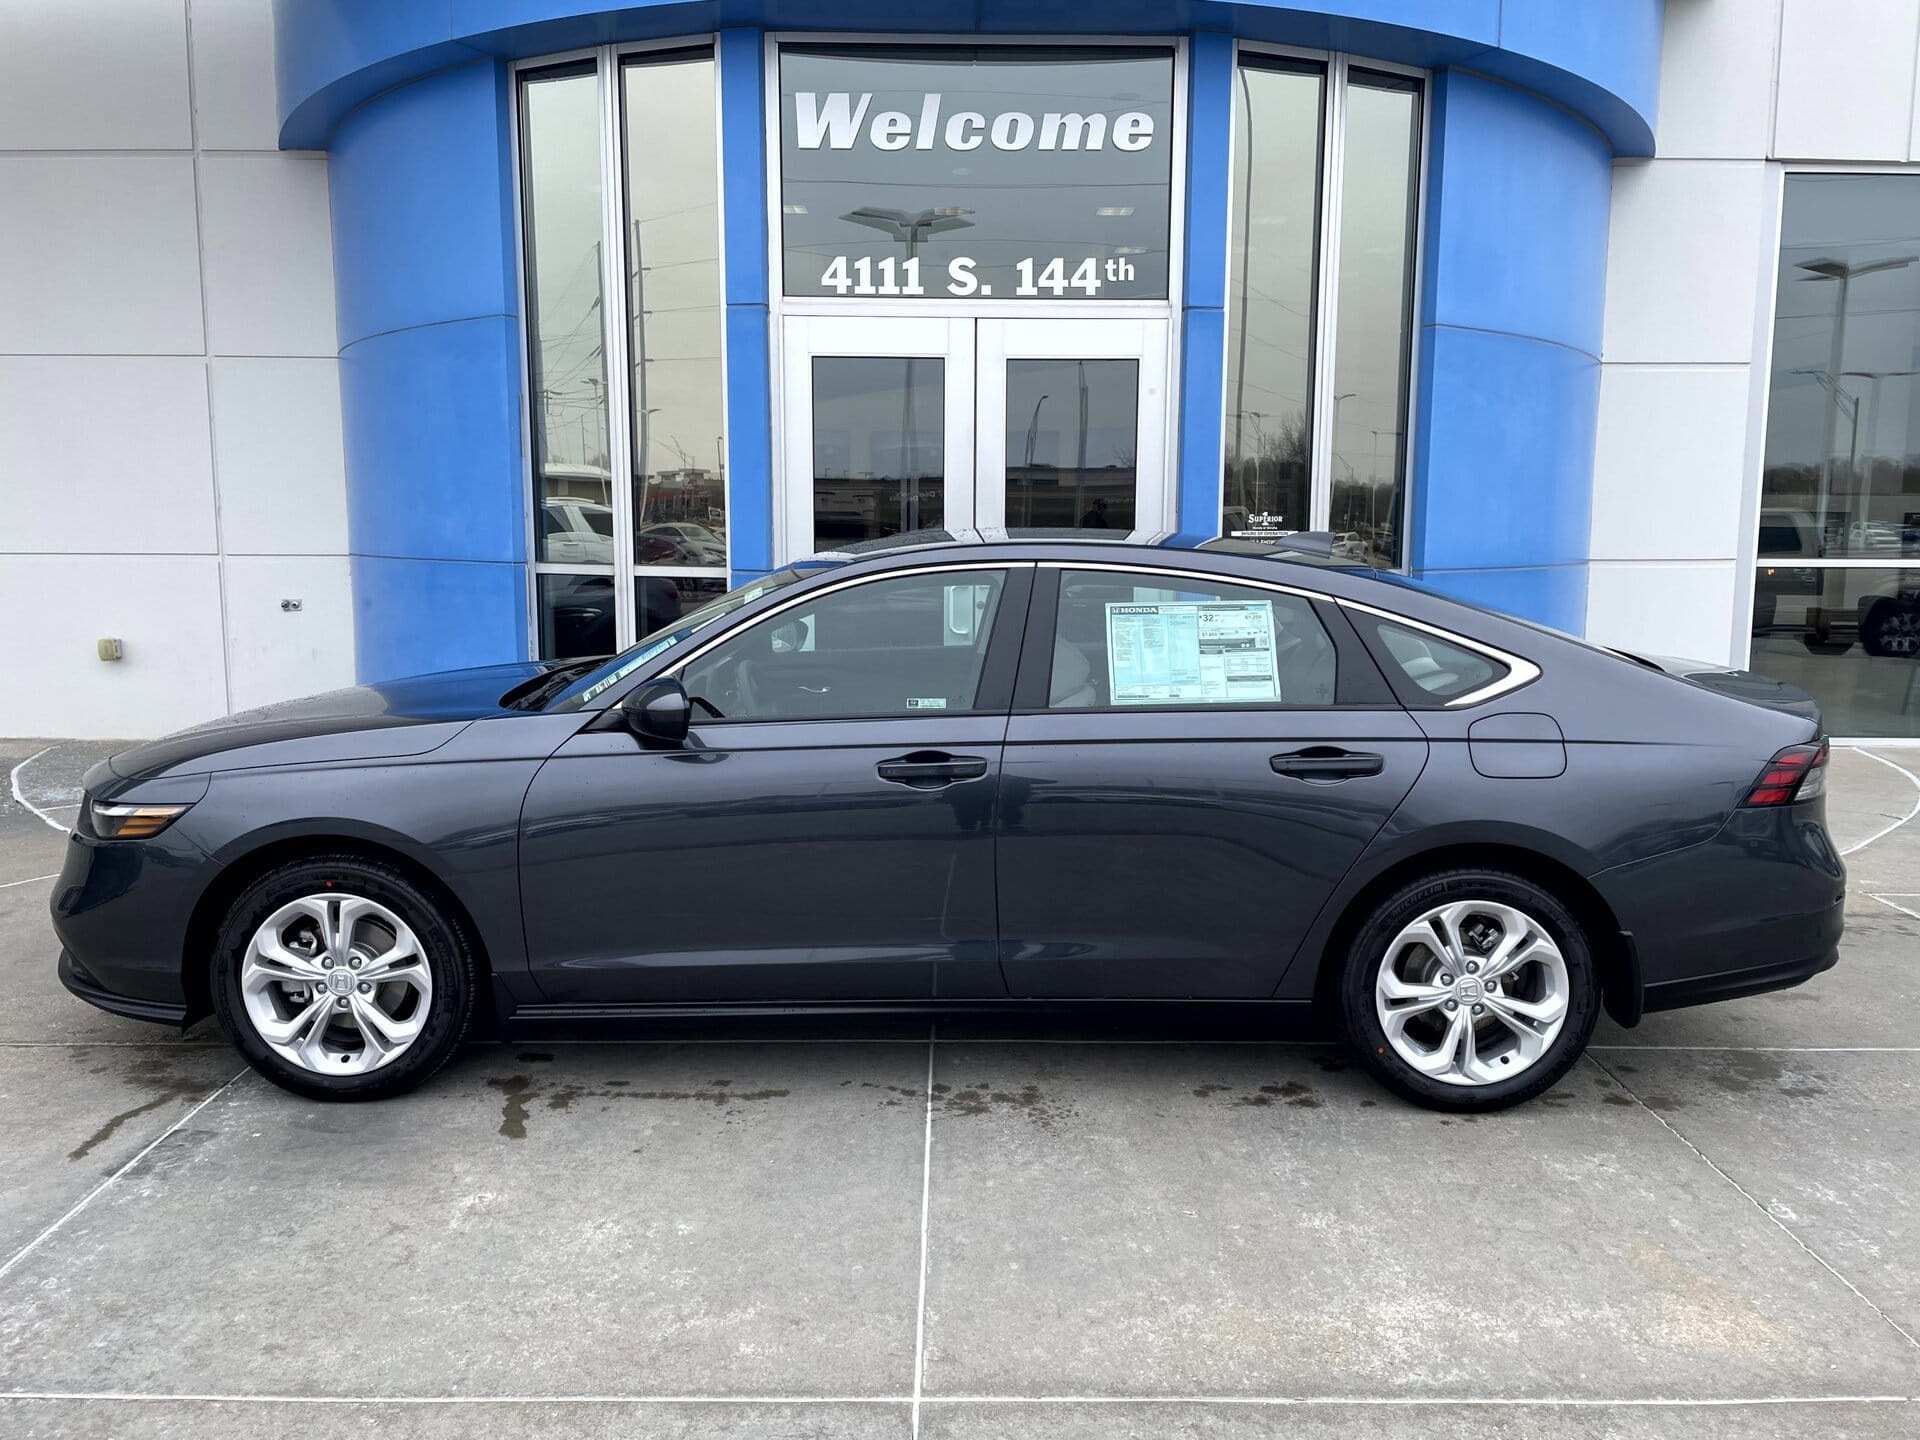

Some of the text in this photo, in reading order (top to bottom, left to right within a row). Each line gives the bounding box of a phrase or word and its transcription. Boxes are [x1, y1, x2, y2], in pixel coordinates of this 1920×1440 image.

[794, 91, 1155, 151] Welcome
[821, 255, 1135, 296] 4111 S. 144th
[1203, 614, 1214, 622] 32
